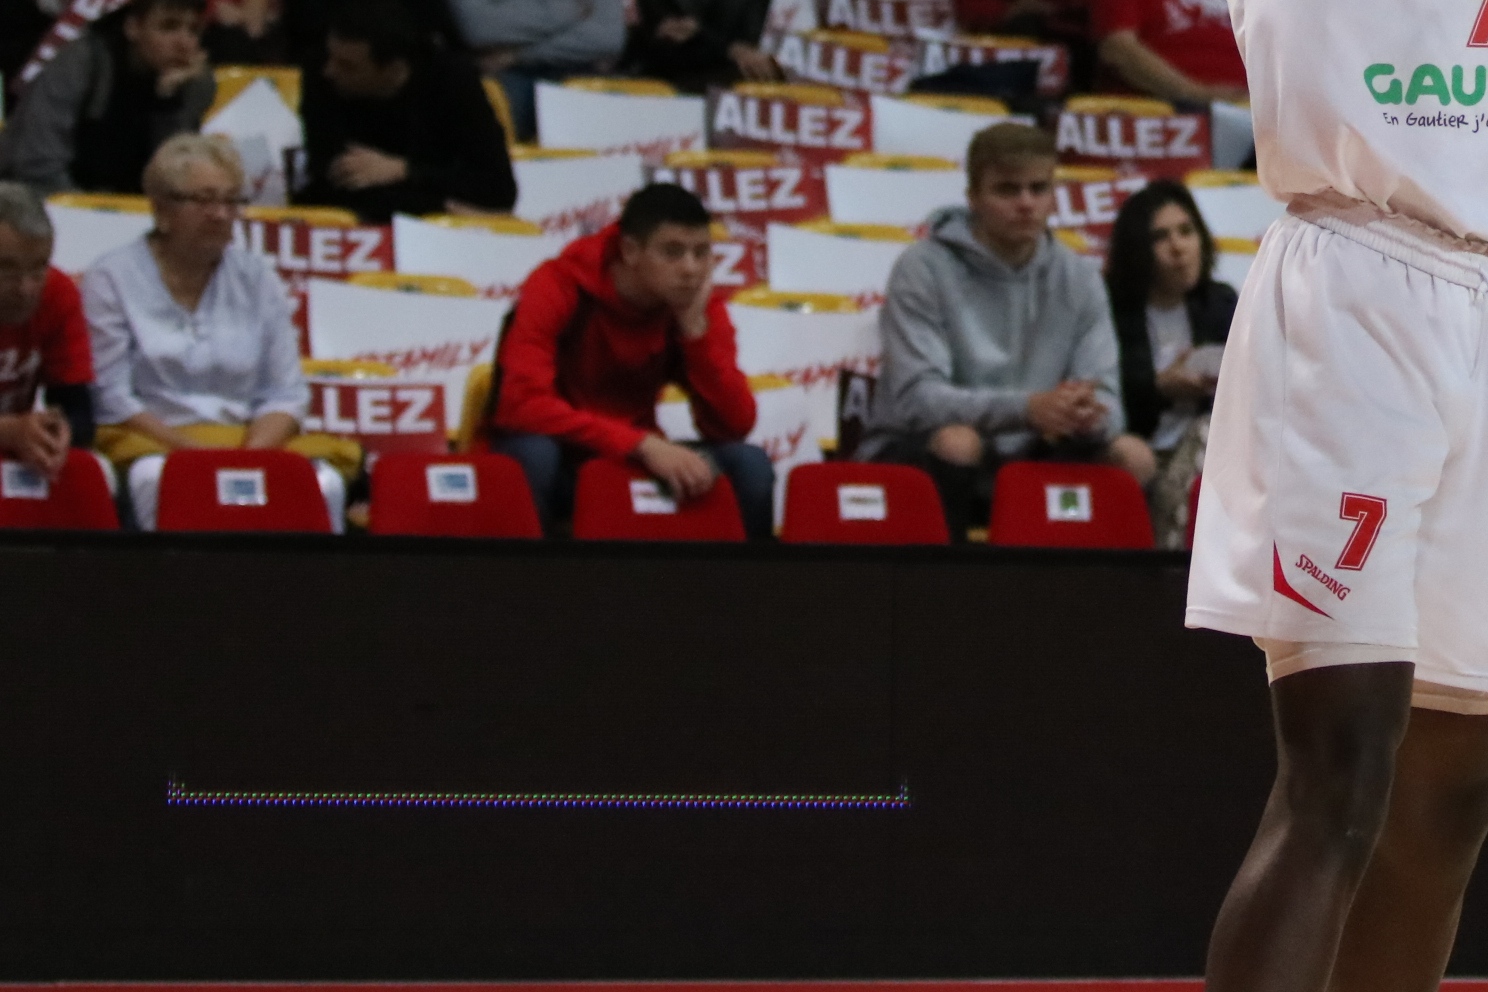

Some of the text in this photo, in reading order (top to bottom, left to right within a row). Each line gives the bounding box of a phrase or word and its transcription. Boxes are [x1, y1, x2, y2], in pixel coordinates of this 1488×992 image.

[712, 90, 865, 148] ALLEZ
[1055, 112, 1200, 158] ALLEZ
[1334, 492, 1388, 571] 7
[1295, 554, 1351, 601] SPALDING
